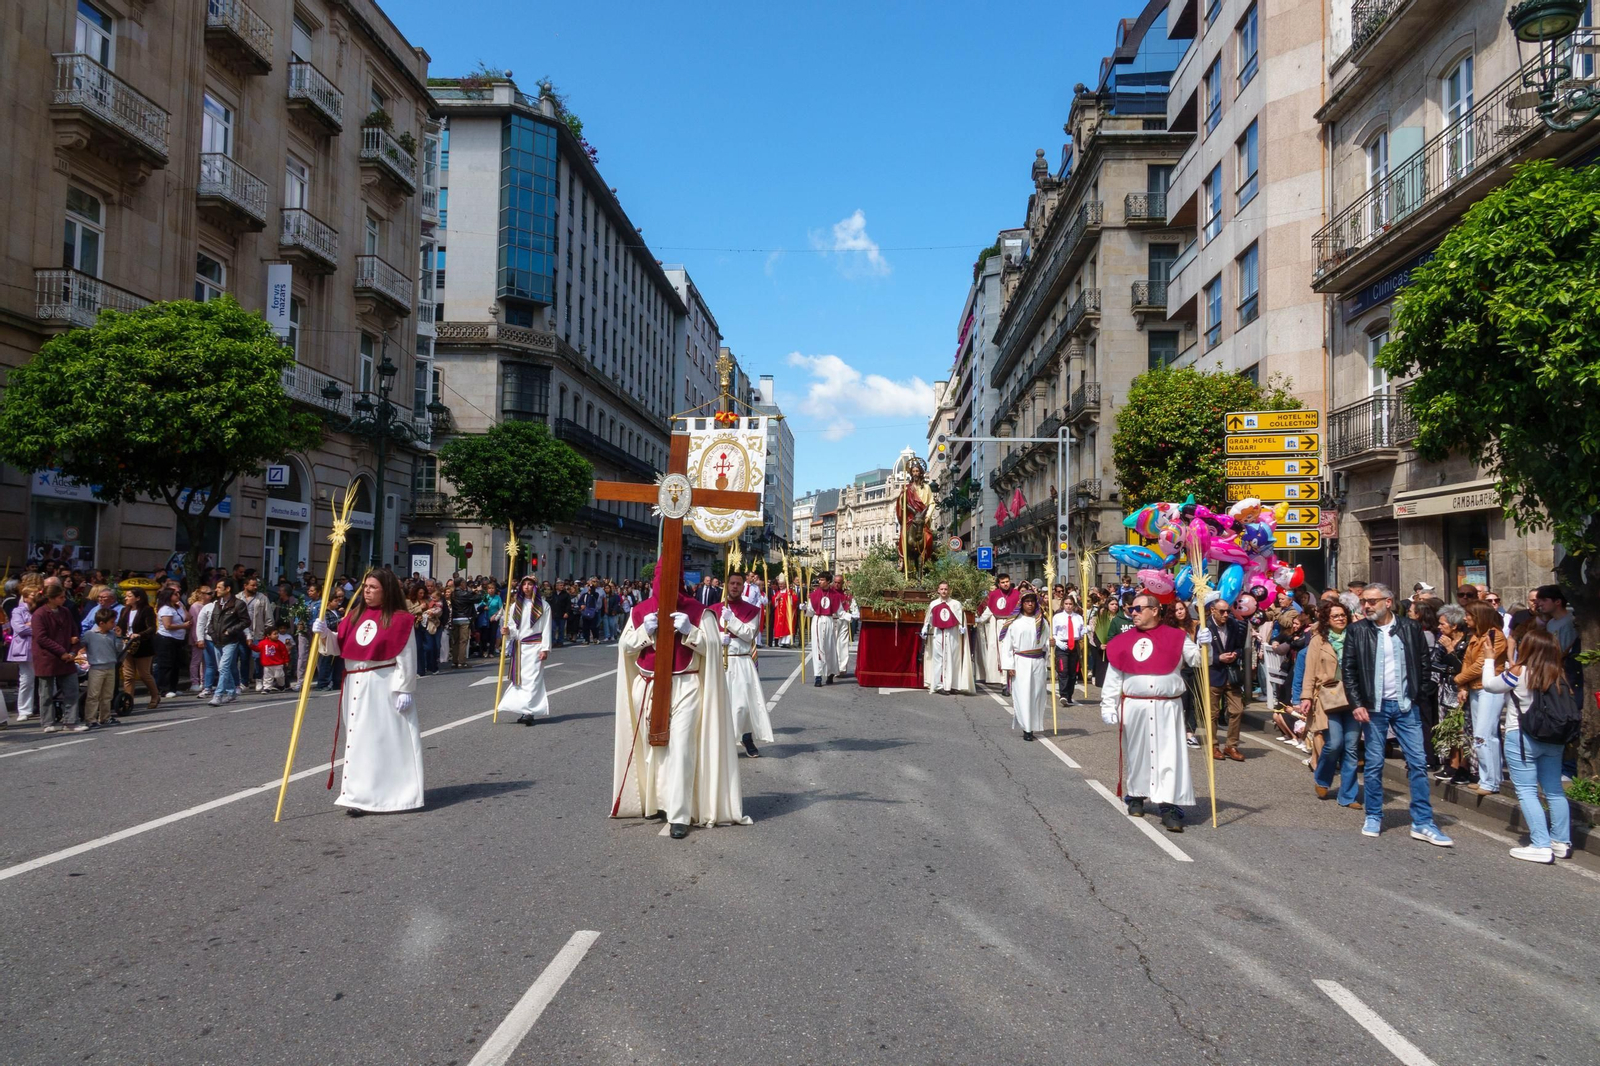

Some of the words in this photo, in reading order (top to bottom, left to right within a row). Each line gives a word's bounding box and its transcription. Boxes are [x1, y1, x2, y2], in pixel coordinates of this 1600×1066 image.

[1372, 270, 1409, 300] Clínicas
[279, 283, 287, 317] mazars
[271, 506, 290, 516] Deutsche
[290, 509, 300, 517] Bank
[981, 550, 988, 559] P
